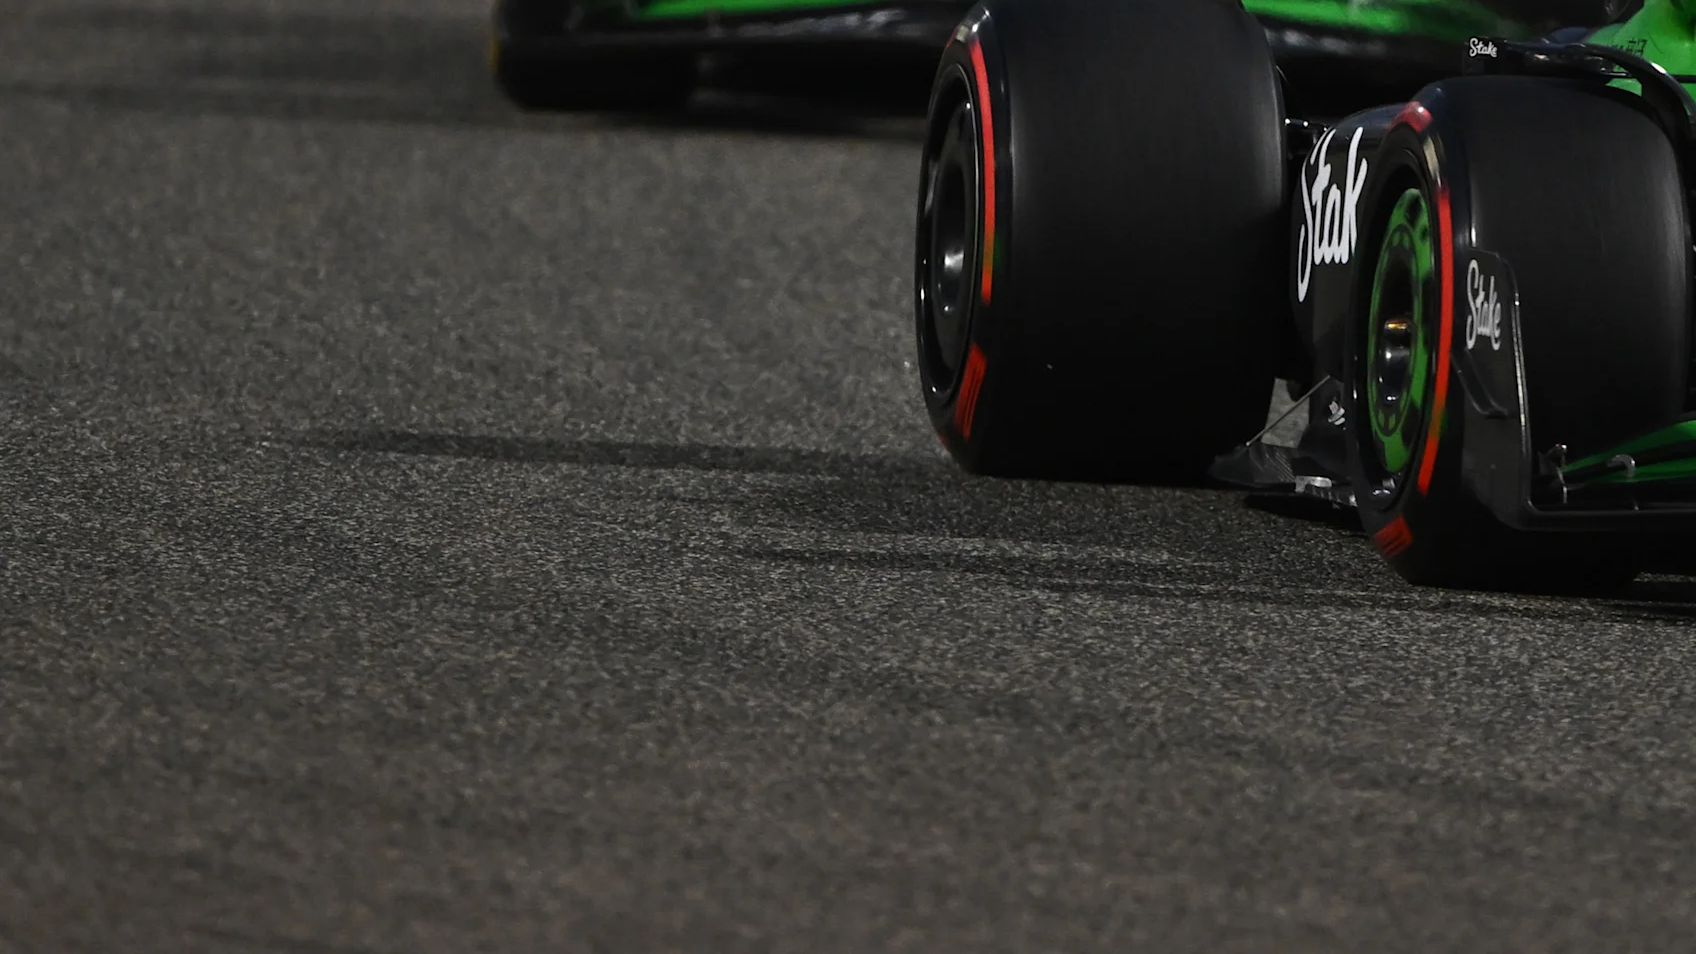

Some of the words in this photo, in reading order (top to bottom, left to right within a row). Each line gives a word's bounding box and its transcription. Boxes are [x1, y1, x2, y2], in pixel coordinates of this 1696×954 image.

[1469, 37, 1498, 58] Stake
[1298, 126, 1368, 302] Stak
[1465, 259, 1501, 350] Stake
